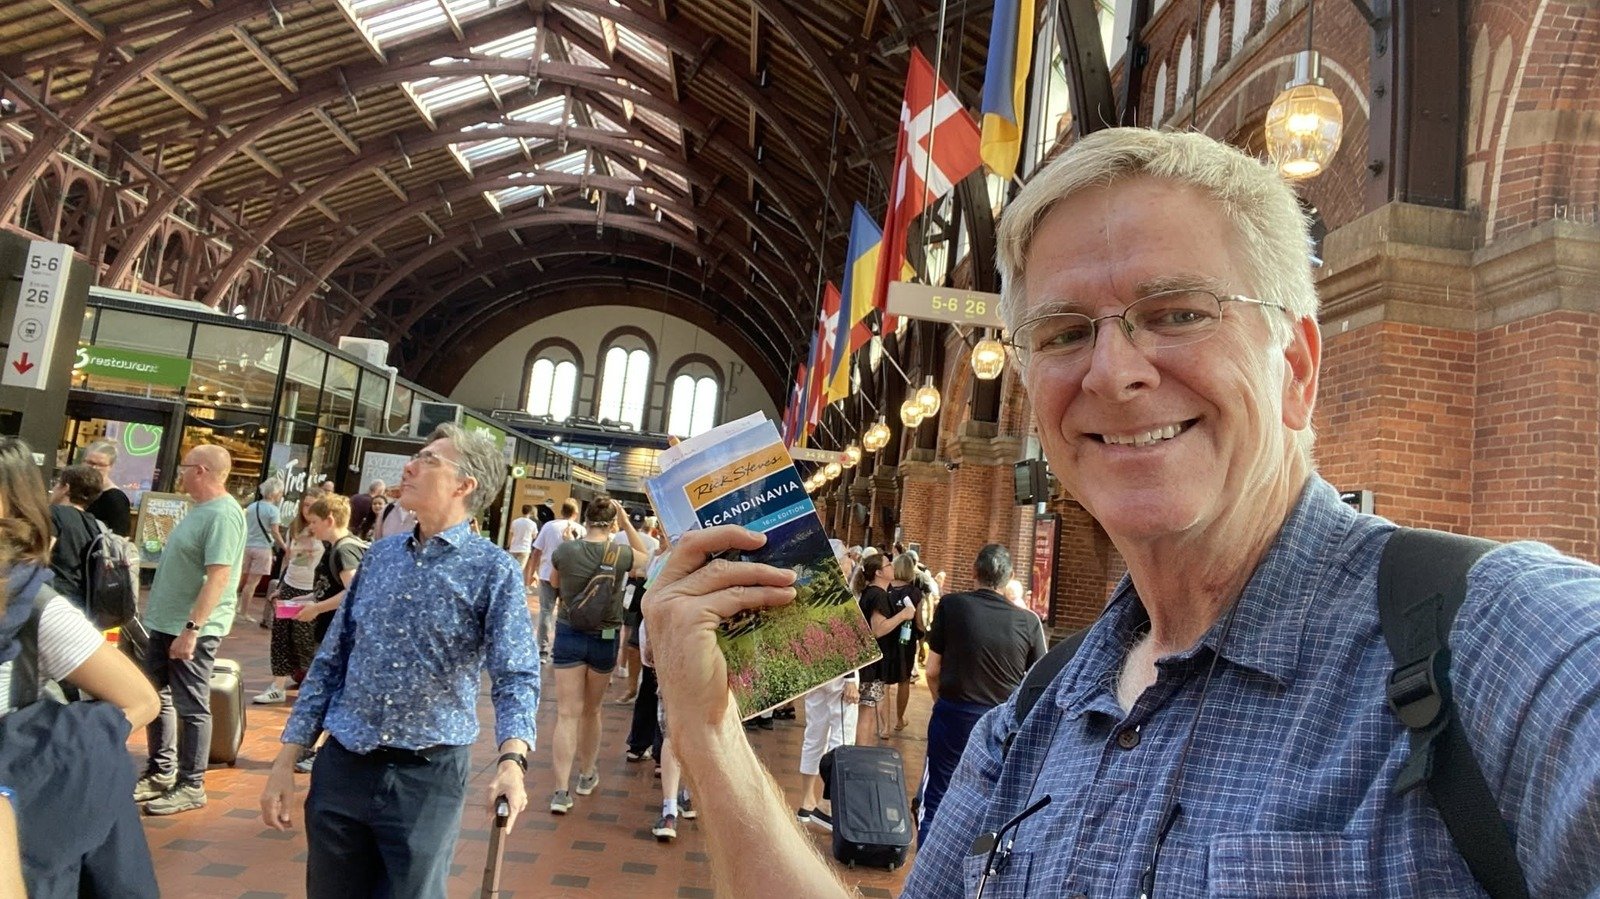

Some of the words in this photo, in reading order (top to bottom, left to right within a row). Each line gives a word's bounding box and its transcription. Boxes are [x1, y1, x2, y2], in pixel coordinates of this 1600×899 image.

[30, 255, 58, 271] 5-6
[26, 288, 49, 304] 26
[931, 295, 958, 312] 5-6
[965, 299, 986, 315] 26
[693, 475, 733, 500] Rick
[732, 455, 782, 481] Steves
[704, 480, 800, 528] SCANDINAVIA
[776, 505, 805, 519] EDITION
